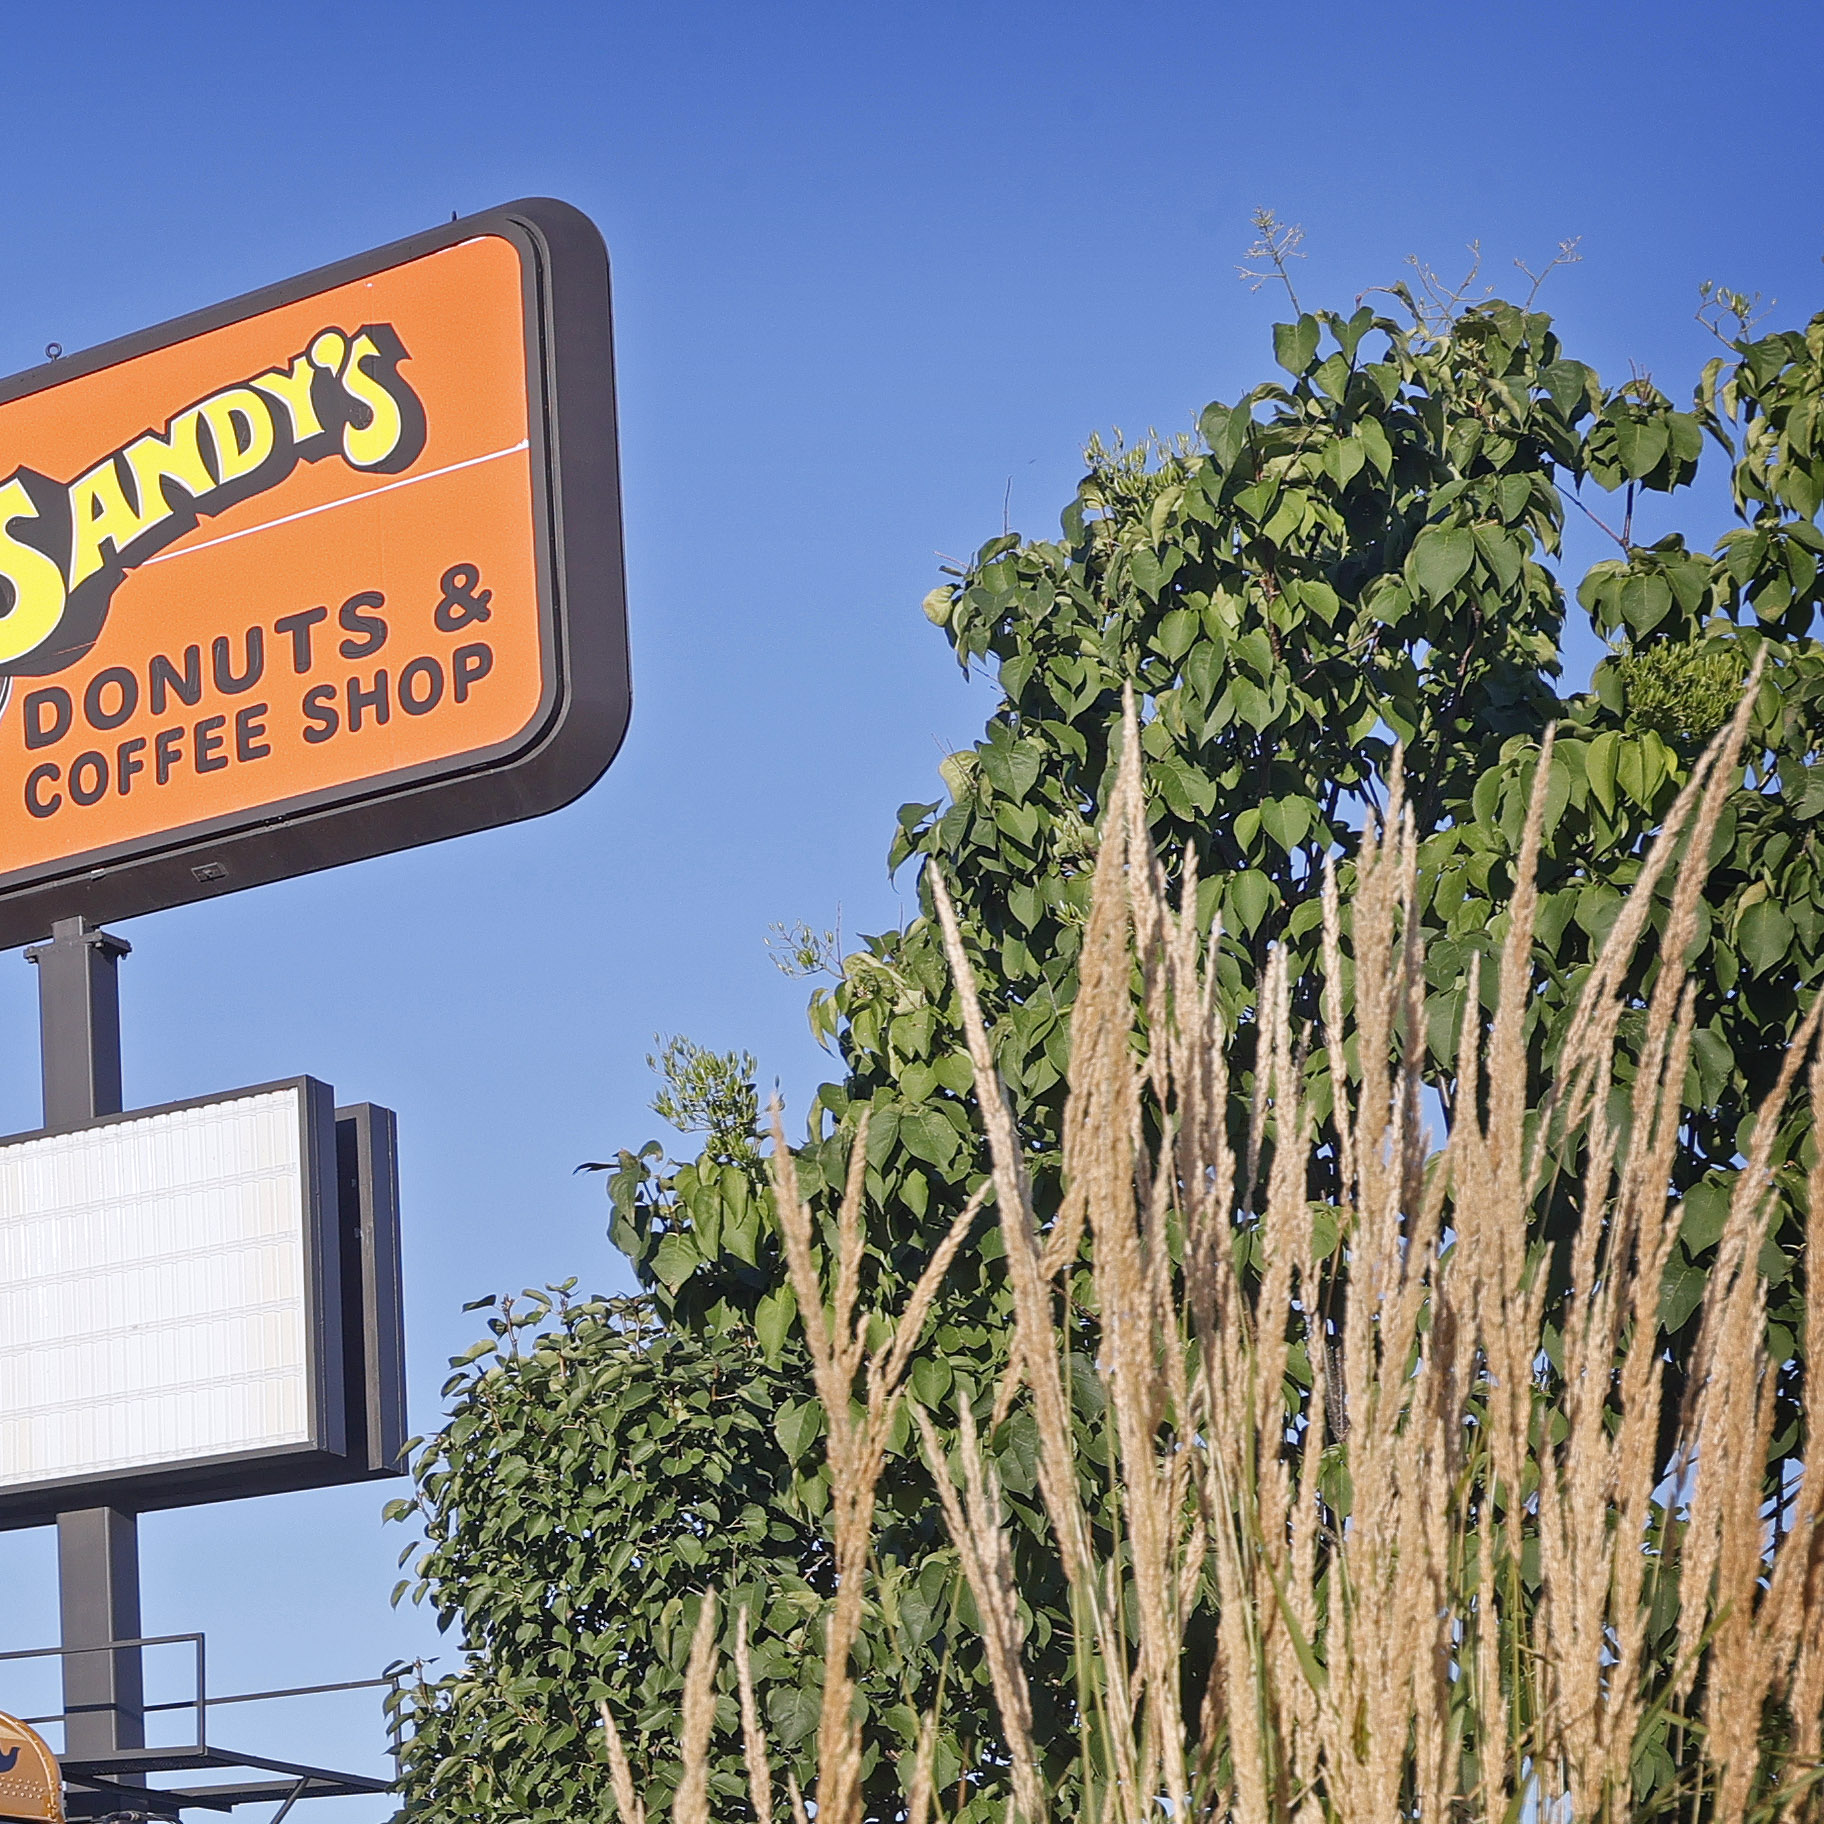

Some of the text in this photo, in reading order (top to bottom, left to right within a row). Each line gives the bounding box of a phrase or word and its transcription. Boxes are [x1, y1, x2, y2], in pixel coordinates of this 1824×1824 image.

[22, 562, 494, 751] DONUTS &
[23, 642, 494, 819] COFFEE SHOP
